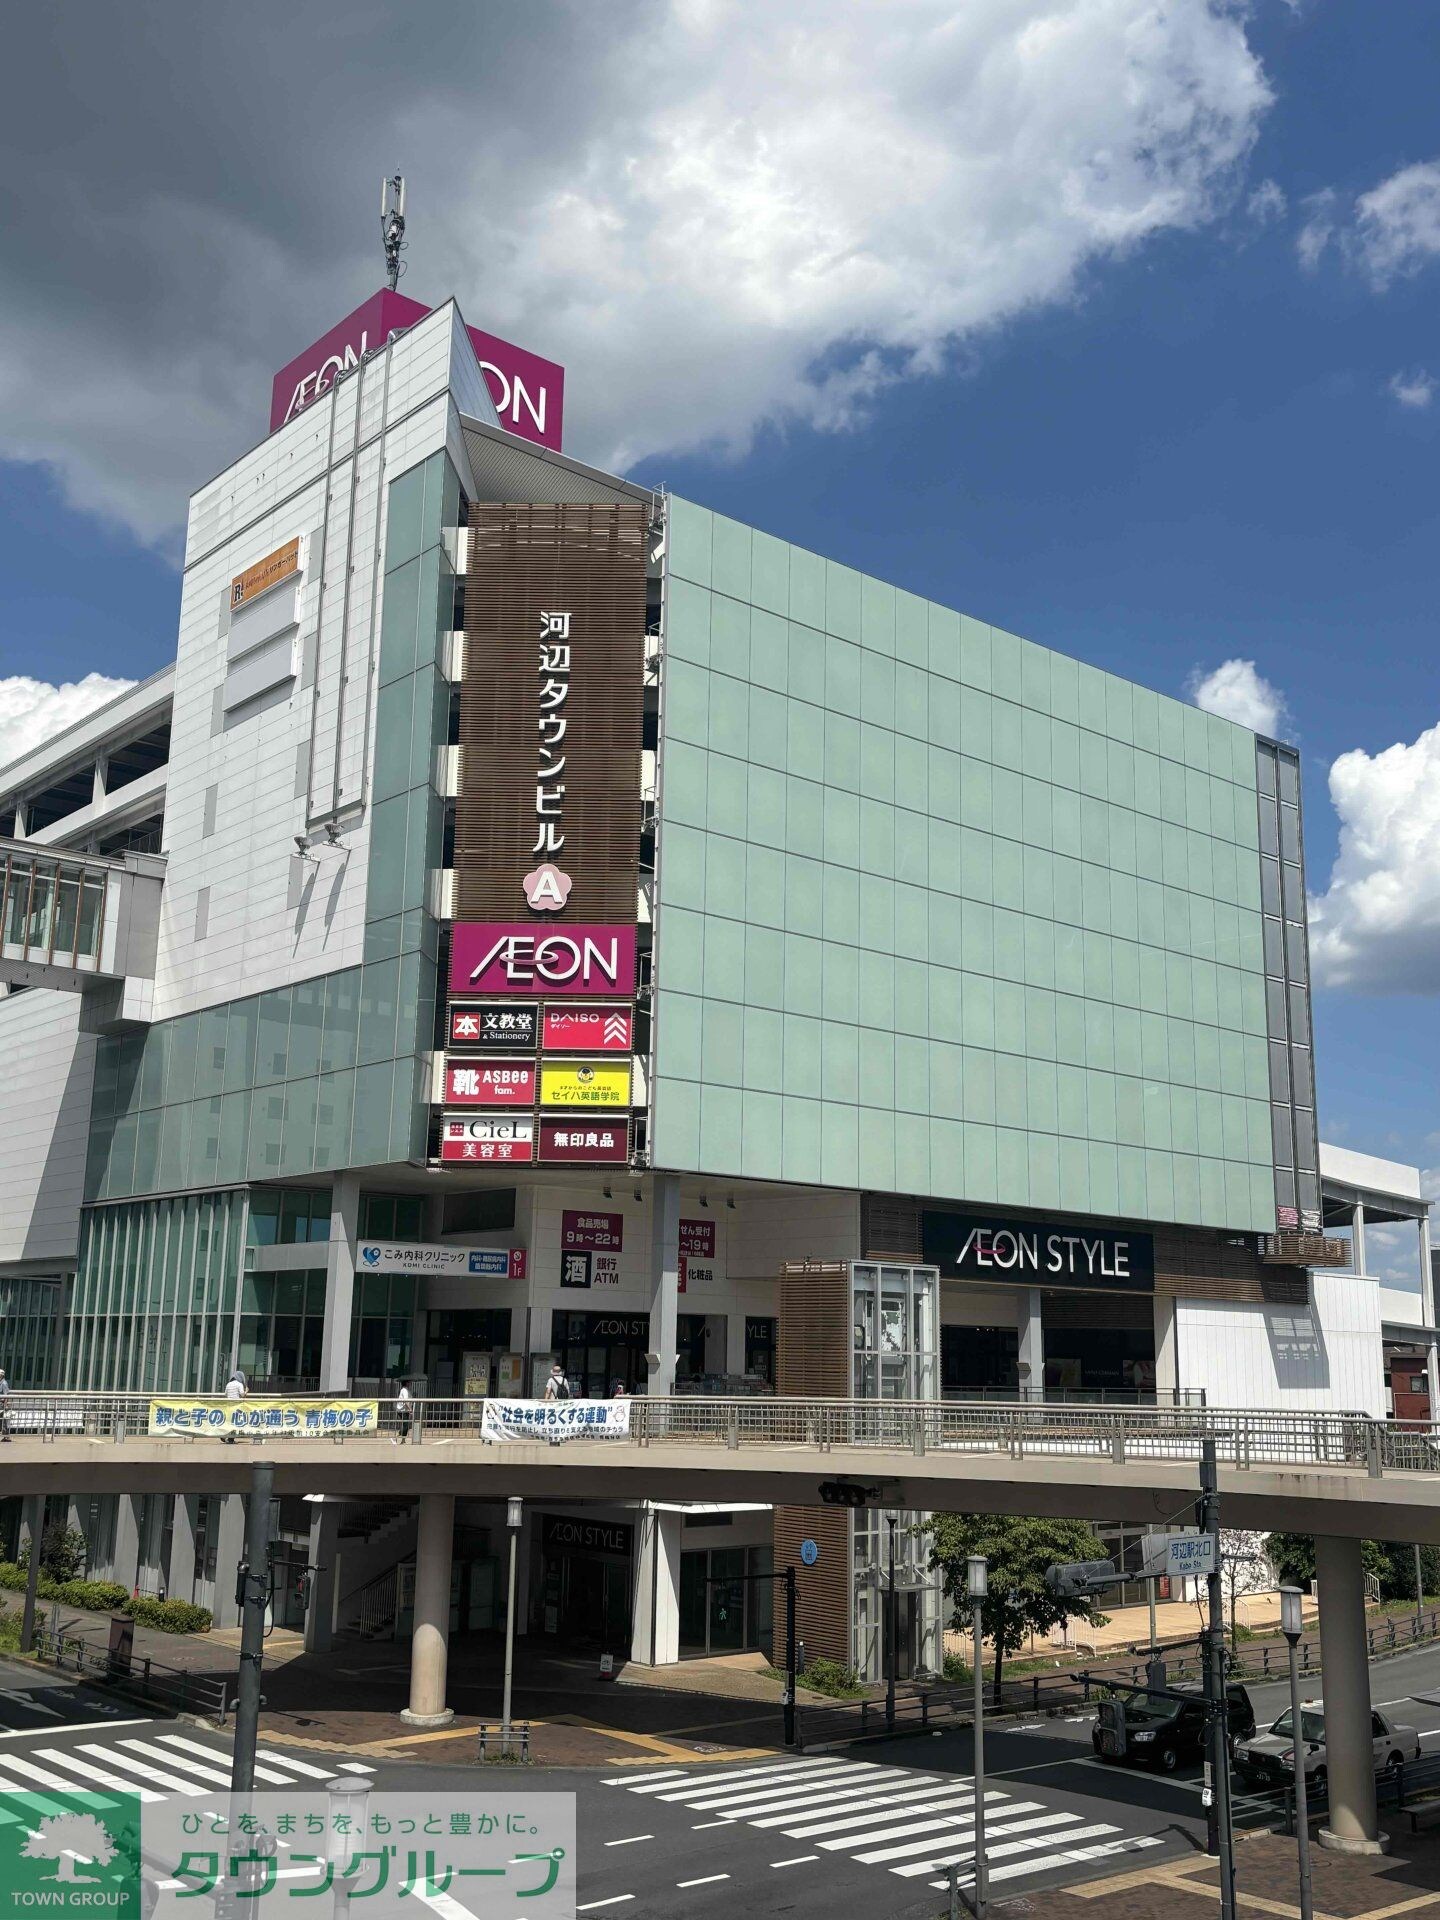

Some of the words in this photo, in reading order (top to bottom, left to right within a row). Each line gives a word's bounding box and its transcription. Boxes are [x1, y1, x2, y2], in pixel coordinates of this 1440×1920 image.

[532, 611, 572, 852] 河辺タウンビル
[530, 871, 563, 903] A
[455, 1015, 479, 1036] 本
[482, 1013, 533, 1029] 文教堂
[550, 1013, 600, 1023] DAISO
[489, 1031, 531, 1041] Stationery
[452, 1068, 479, 1096] 靴
[551, 1091, 620, 1101] セイハ英語学院
[553, 1132, 614, 1148] 無印良品
[462, 1143, 513, 1158] 美容室
[577, 1217, 609, 1230] 食品売場
[384, 1249, 466, 1263] こみ内科クリニック
[1047, 1234, 1130, 1277] STYLE
[565, 1255, 588, 1283] 酒
[596, 1258, 618, 1271] 銀行
[594, 1272, 619, 1284] ATM
[688, 1268, 714, 1281] 化粧品
[155, 1407, 227, 1428] 親と子の
[231, 1408, 300, 1428] 心が通う
[305, 1408, 373, 1428] 青梅の子
[585, 1526, 624, 1549] STYLE
[1171, 1541, 1211, 1560] 河辺駅北口
